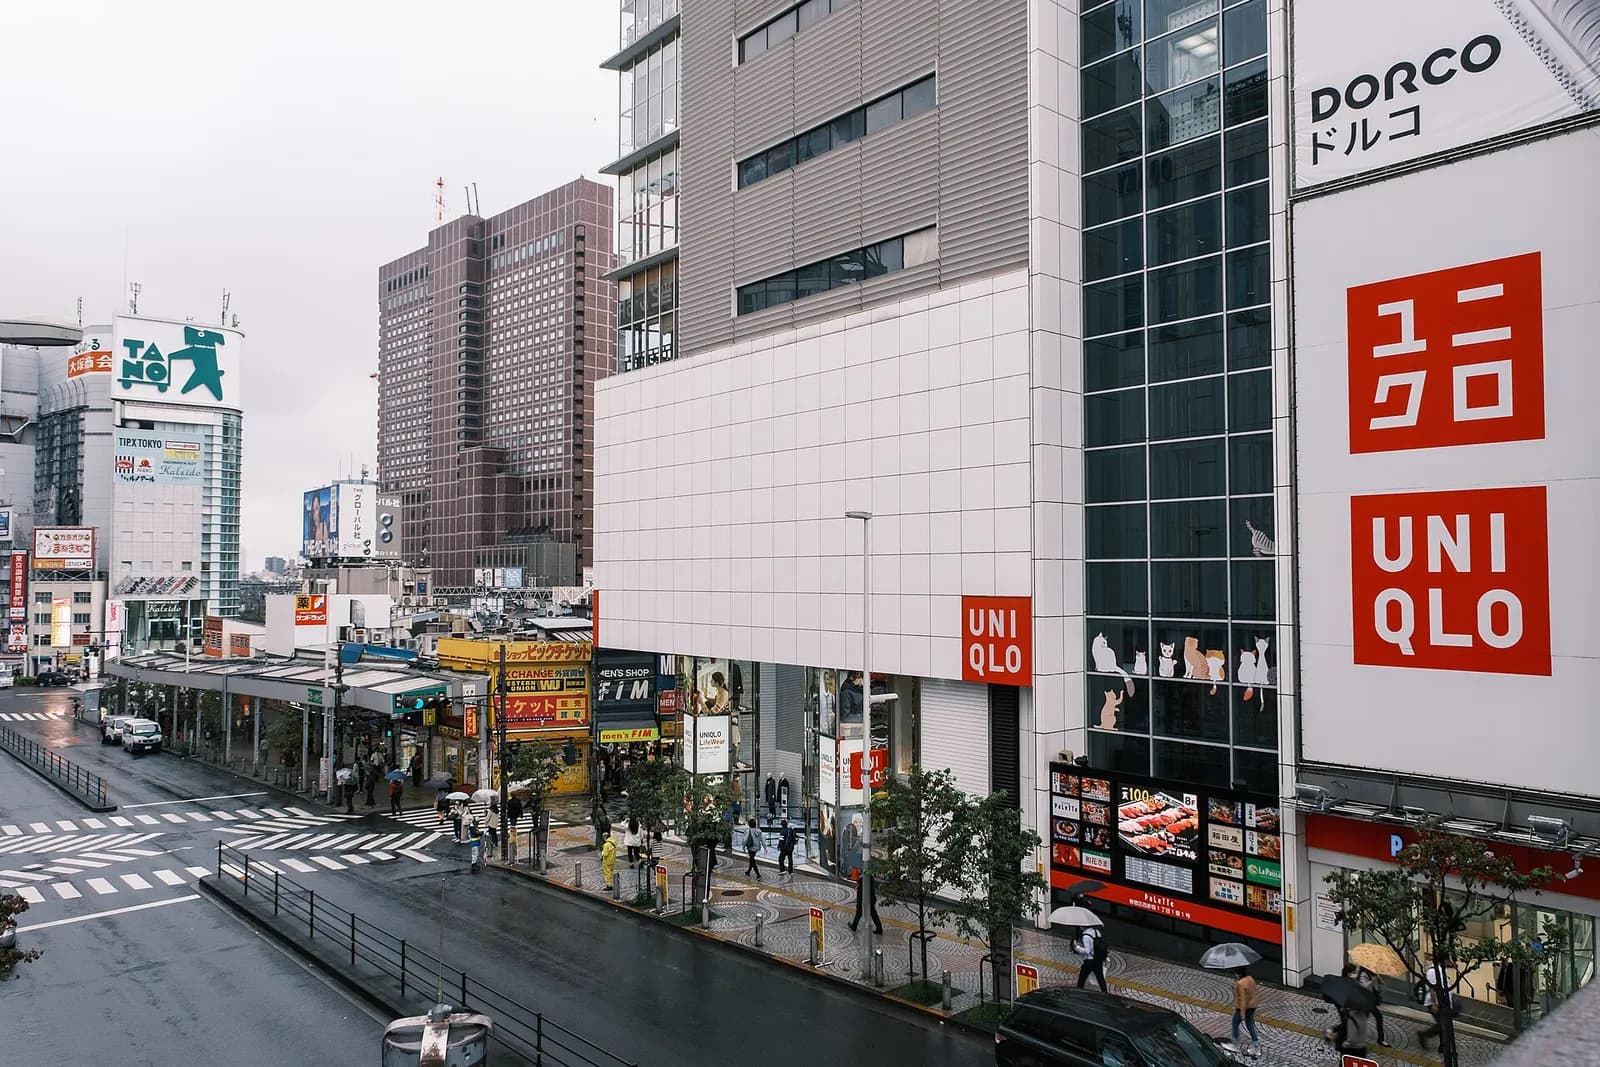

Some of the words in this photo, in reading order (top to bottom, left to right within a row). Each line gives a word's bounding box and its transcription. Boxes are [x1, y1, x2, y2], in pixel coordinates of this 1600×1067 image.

[1311, 34, 1501, 124] DORCO
[1312, 104, 1421, 166] ドルコ
[1372, 282, 1512, 359] ユニ
[123, 339, 165, 362] TA
[122, 358, 168, 382] NO
[1368, 358, 1514, 431] クロ
[138, 438, 163, 449] TOKYO
[159, 465, 201, 477] Kaleido
[53, 543, 90, 554] まねきねこ
[1372, 512, 1507, 574] UNI
[297, 597, 310, 608] 薬
[969, 608, 1016, 638] UNI
[1373, 587, 1524, 656] QLO
[969, 643, 1022, 677] QLO
[504, 669, 554, 679] XCHANGE
[625, 669, 650, 677] SHOP
[540, 679, 561, 690] WU
[602, 732, 629, 740] men's
[631, 729, 652, 738] FIM
[700, 730, 722, 738] UNIQLO
[700, 738, 726, 746] LifeWear
